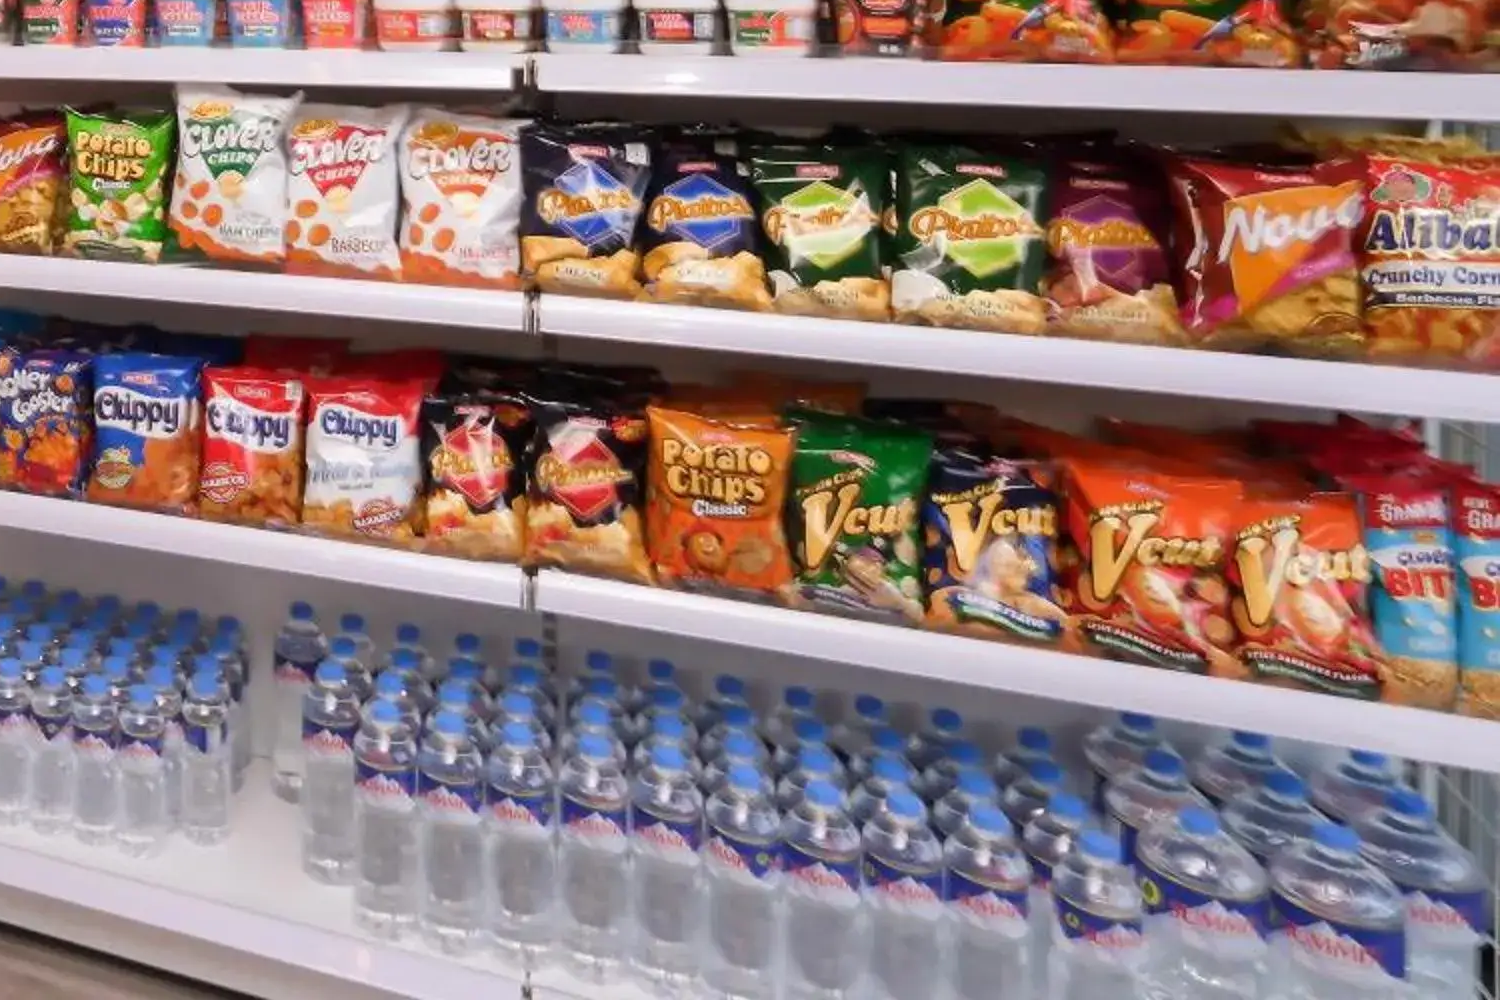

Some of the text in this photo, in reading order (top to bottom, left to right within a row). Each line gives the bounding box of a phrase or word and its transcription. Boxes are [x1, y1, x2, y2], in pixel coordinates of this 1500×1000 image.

[75, 130, 153, 156] Potato
[181, 117, 277, 158] CLOVER
[291, 132, 385, 176] CLOVER
[76, 152, 148, 181] Chips
[207, 150, 257, 165] CHIPS
[313, 165, 363, 181] CHIPS
[409, 138, 513, 180] CLOVER
[1366, 268, 1447, 287] Crunchy
[98, 390, 181, 435] Chippy
[321, 407, 398, 448] Chippy
[661, 439, 772, 475] Potato
[665, 465, 766, 503] Chips
[692, 499, 748, 517] Classic
